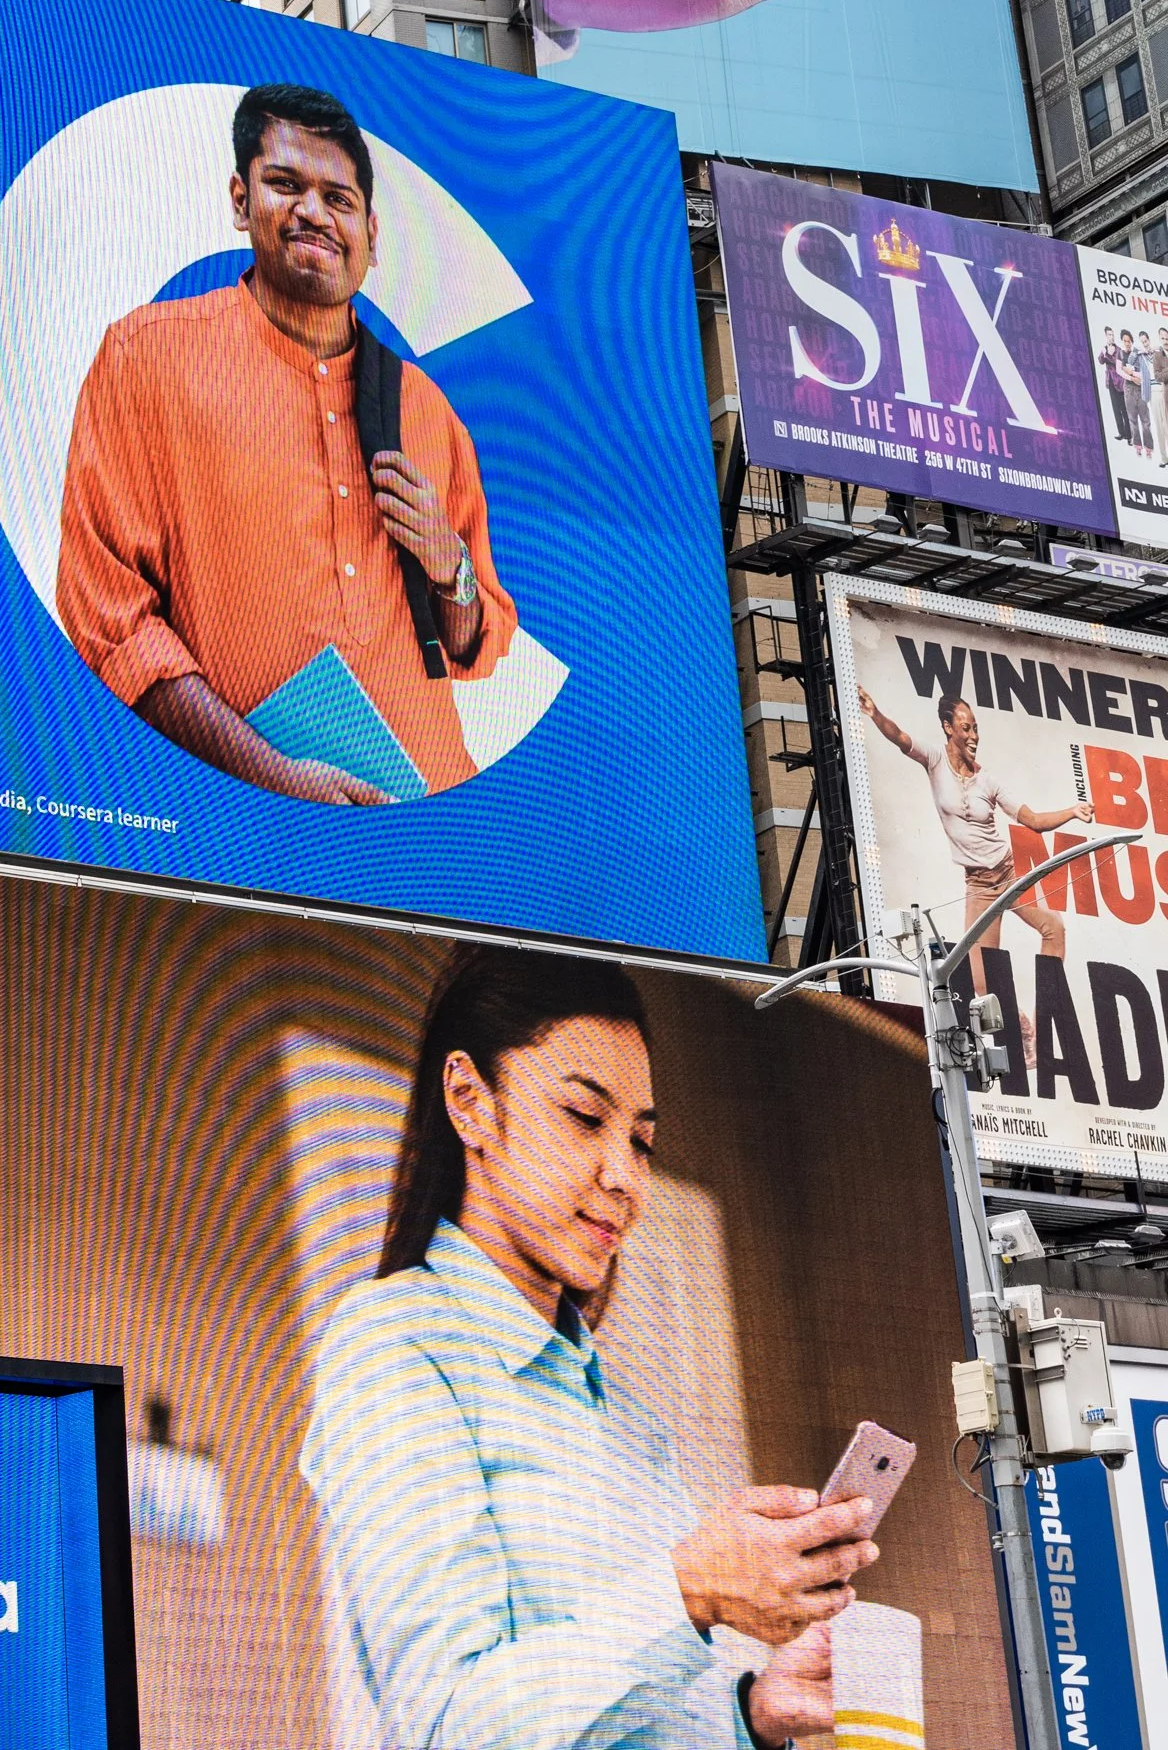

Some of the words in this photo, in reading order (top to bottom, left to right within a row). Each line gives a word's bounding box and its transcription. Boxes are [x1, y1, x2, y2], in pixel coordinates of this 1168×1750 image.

[1092, 287, 1127, 307] AND
[850, 396, 897, 434] THE
[908, 407, 1014, 460] MUSICAL
[791, 424, 829, 447] BROOKS
[831, 431, 877, 457] ATKINSON
[878, 440, 919, 465] THEATRE
[925, 450, 943, 469] 256
[945, 453, 954, 470] W
[956, 456, 980, 477] 47TH
[980, 461, 992, 481] ST
[998, 466, 1092, 501] SIXONBROADWAY.COM
[1070, 743, 1088, 803] INCLUDING
[35, 795, 114, 824] Coursera
[117, 807, 179, 834] learner
[1002, 1117, 1048, 1138] MITCHELL
[1088, 1127, 1124, 1148] RACHEL
[1127, 1132, 1167, 1153] CHAVKIN
